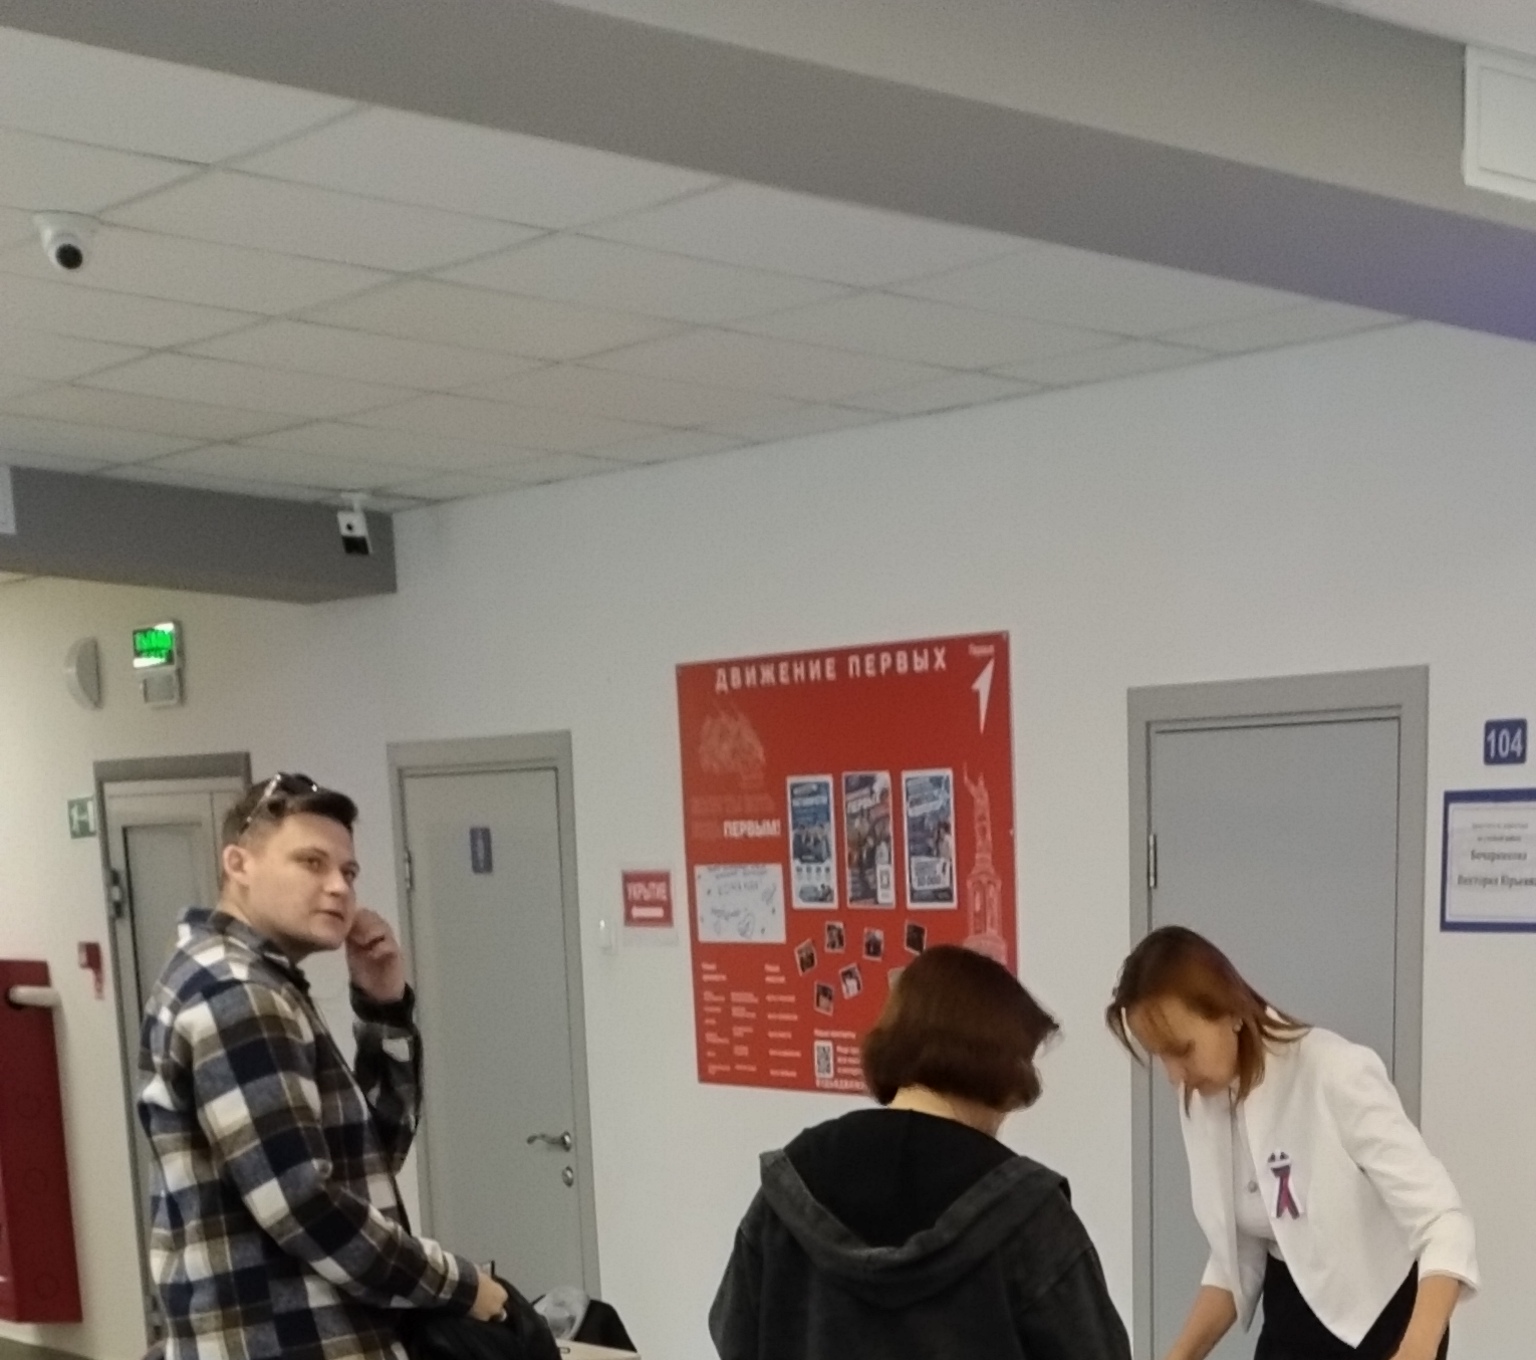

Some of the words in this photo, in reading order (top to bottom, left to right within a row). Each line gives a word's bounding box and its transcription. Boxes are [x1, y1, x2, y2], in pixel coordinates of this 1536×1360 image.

[715, 656, 836, 694] ДВИЖЕНИЕ
[848, 646, 947, 679] ПЕРВЫХ
[1486, 727, 1523, 759] 104
